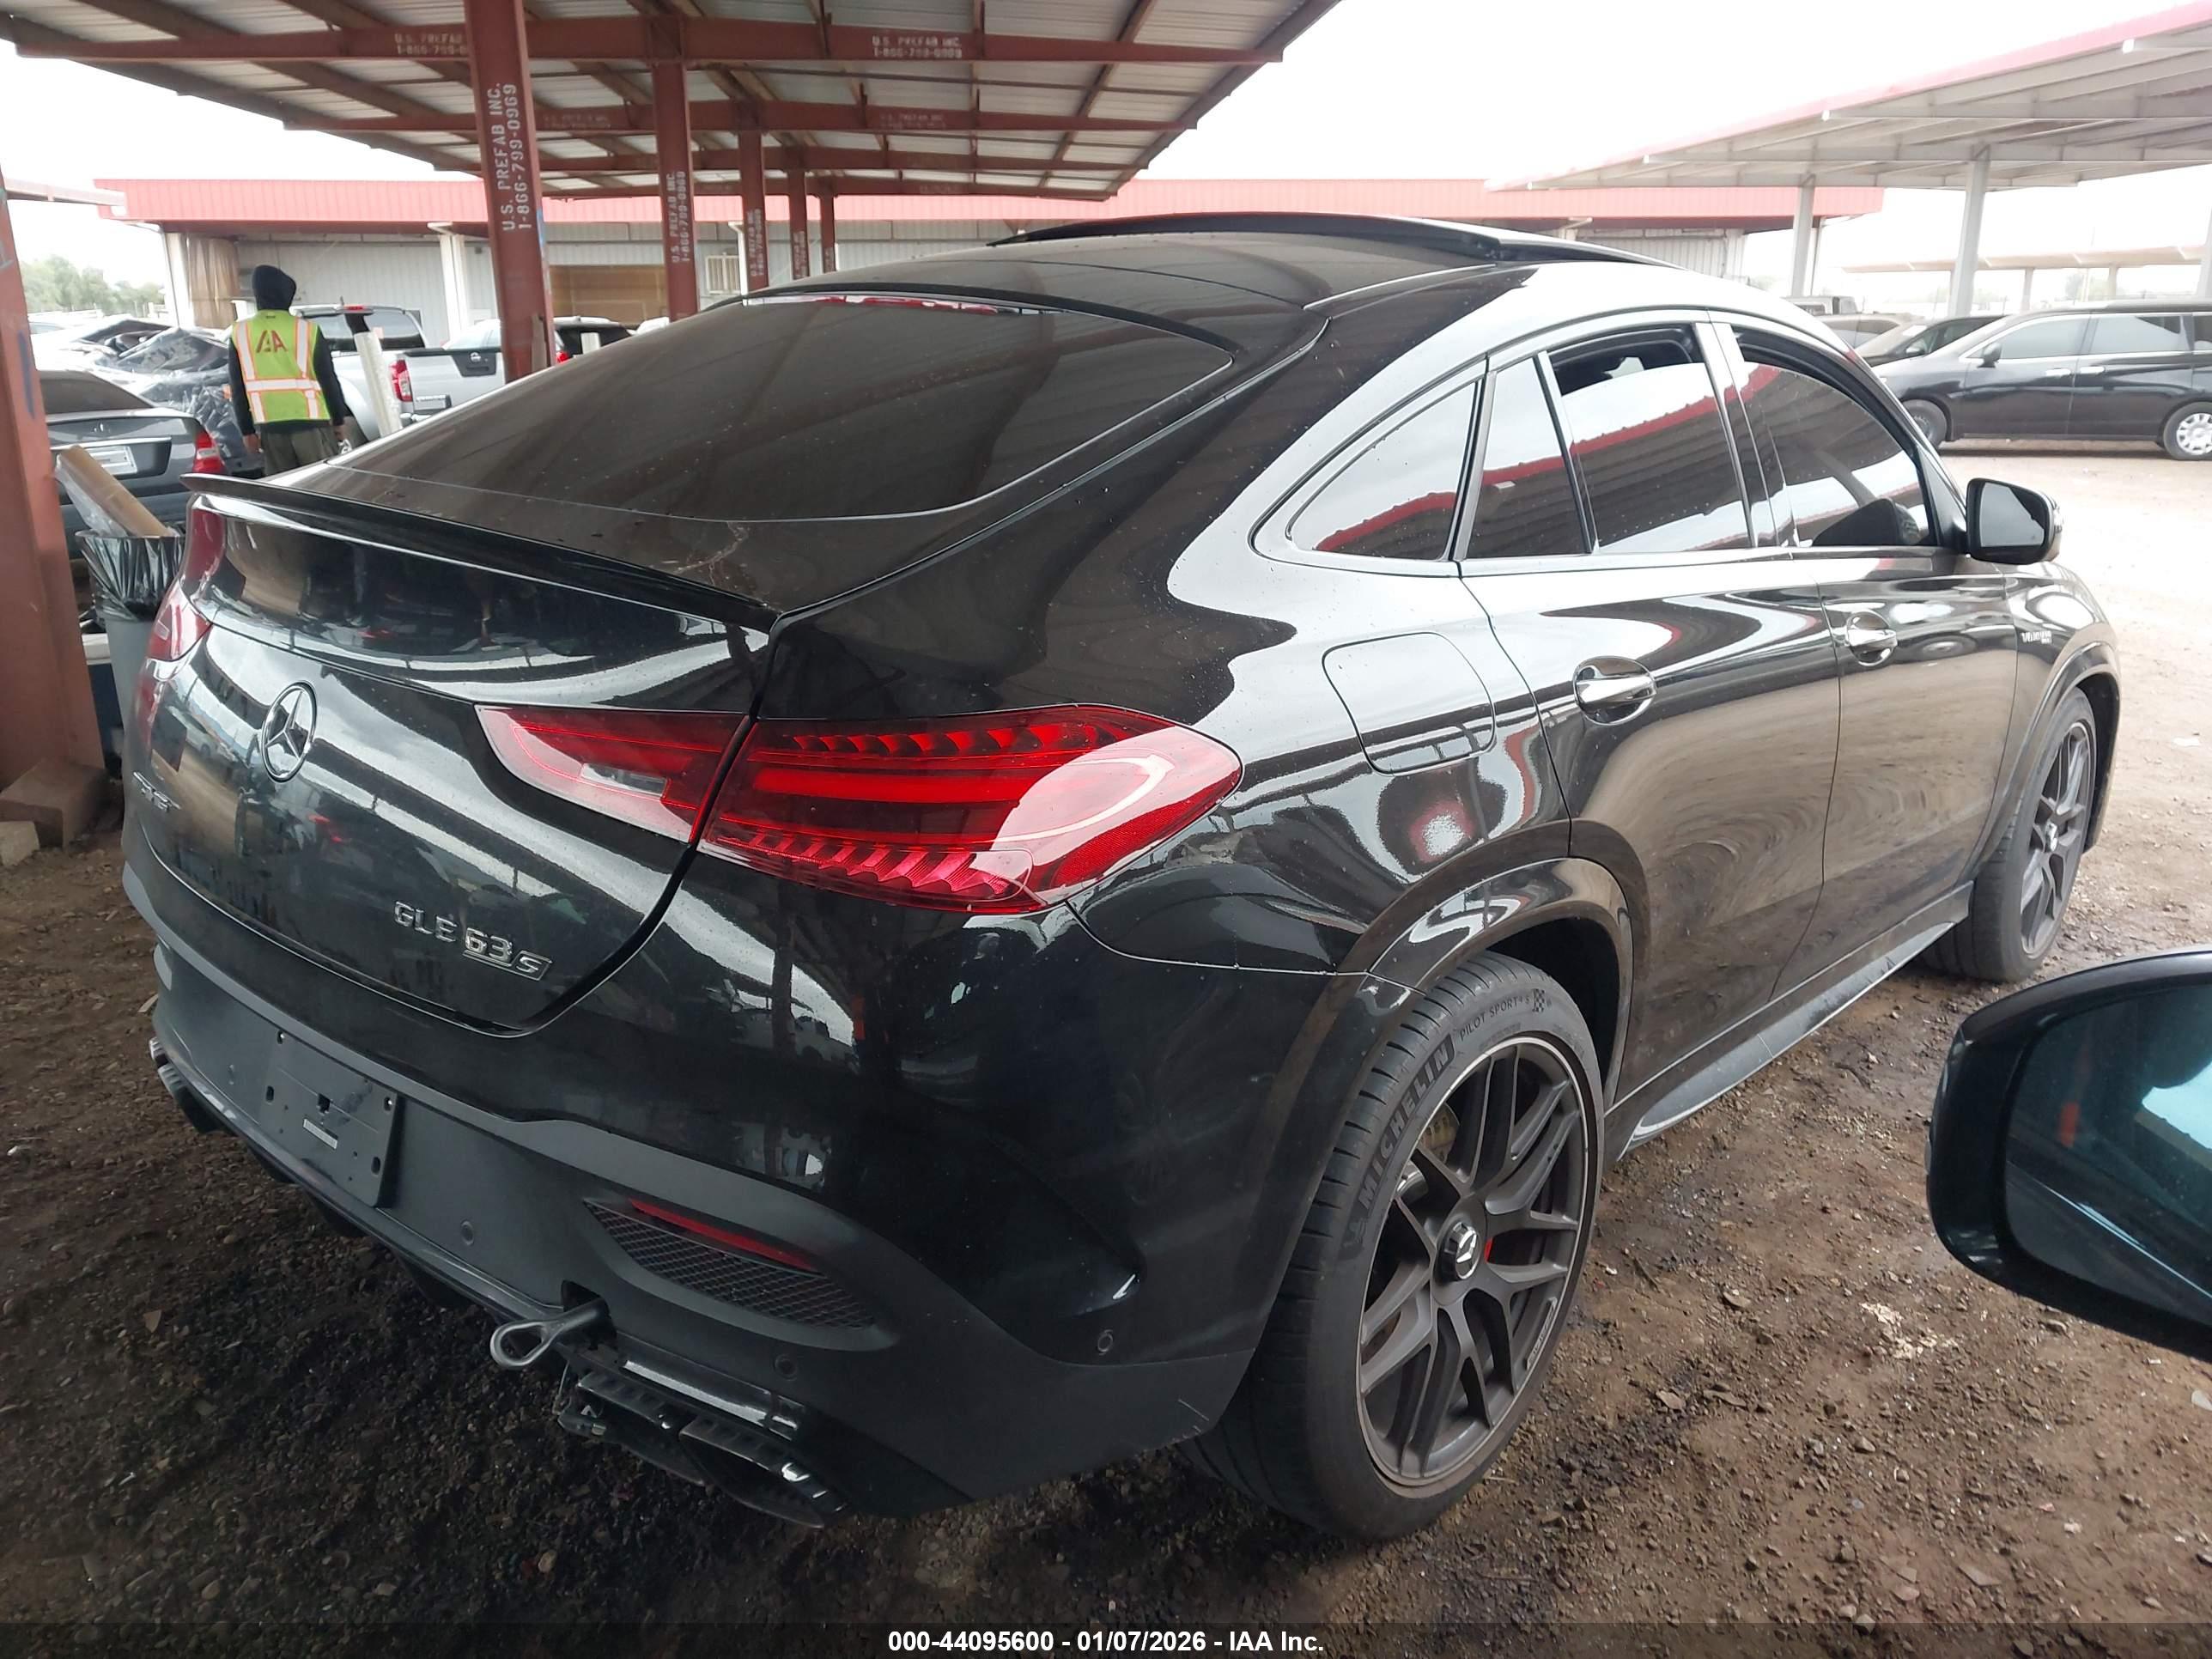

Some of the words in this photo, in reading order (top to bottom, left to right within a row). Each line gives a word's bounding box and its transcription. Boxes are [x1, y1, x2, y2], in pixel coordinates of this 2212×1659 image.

[487, 82, 503, 116] INC.
[491, 124, 511, 190] PREFAB
[502, 83, 532, 230] 1-866-799-0969
[501, 200, 515, 231] U.S.
[394, 902, 459, 943] GLE
[465, 927, 514, 963] 63
[1459, 1012, 1486, 1042] PILOT
[1488, 996, 1518, 1018] SPORT
[1358, 1042, 1452, 1210] MICHELIN
